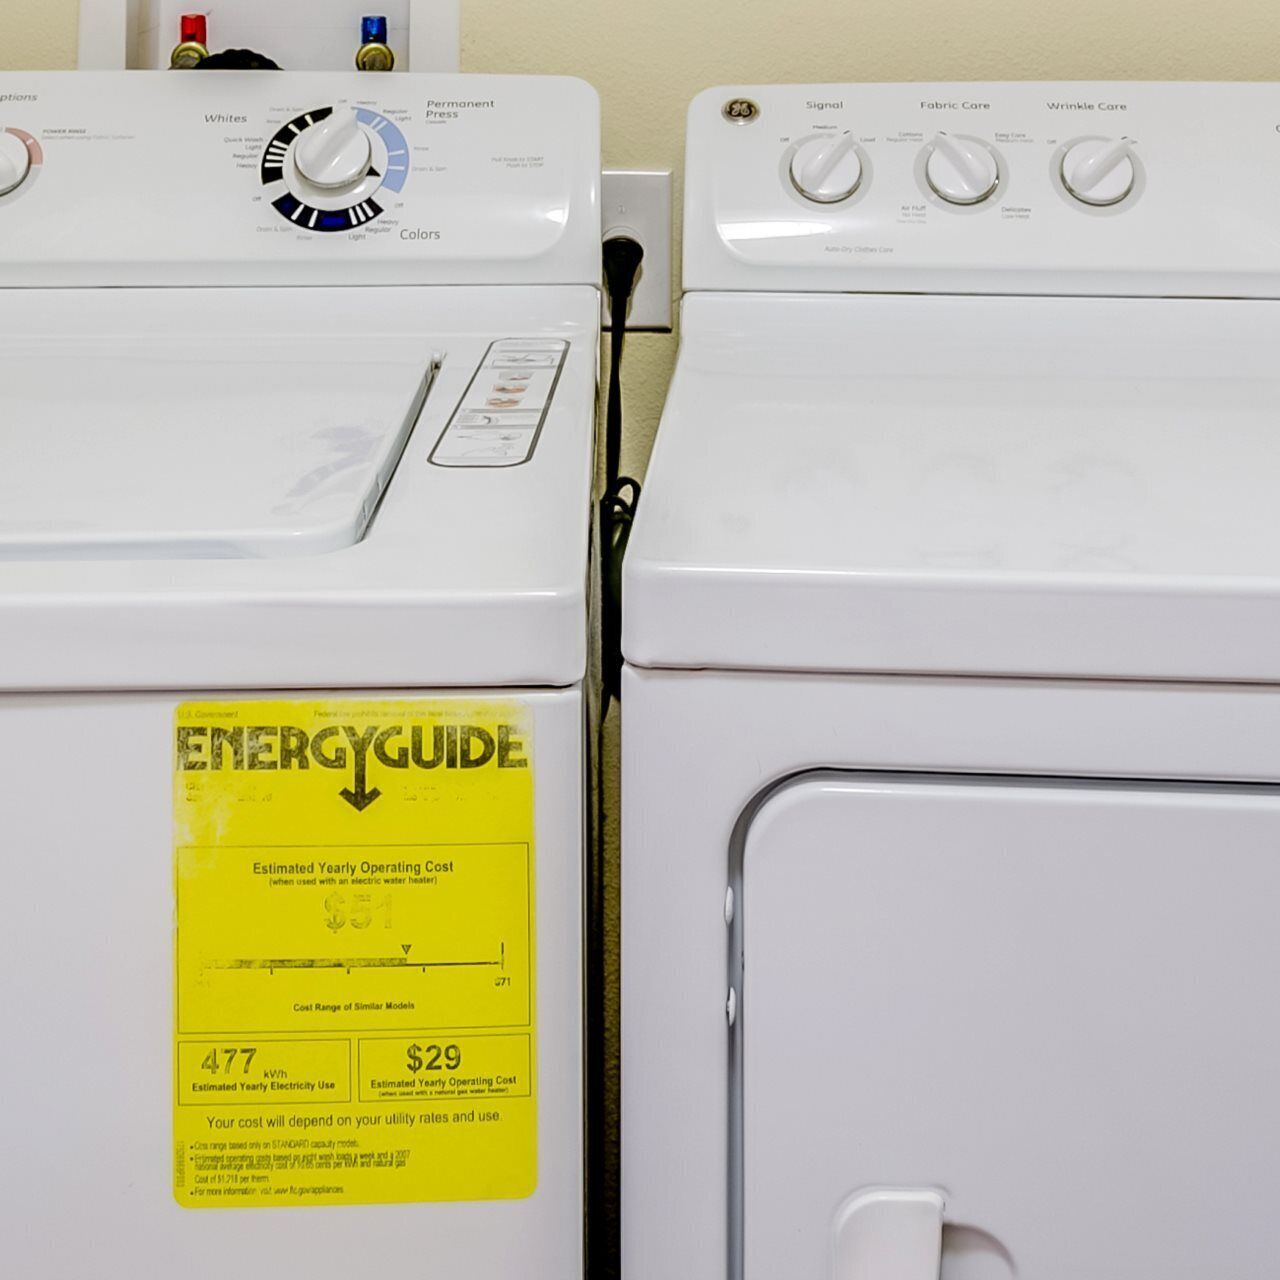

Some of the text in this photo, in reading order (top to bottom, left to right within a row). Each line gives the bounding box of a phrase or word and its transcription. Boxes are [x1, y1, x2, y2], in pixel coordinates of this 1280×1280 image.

[427, 100, 495, 108] Permanent
[806, 101, 843, 111] Signal
[920, 101, 991, 110] Fabric Care
[1047, 102, 1127, 111] Wrinkle Care
[204, 114, 247, 123] Whites
[426, 110, 459, 118] Press
[365, 226, 391, 234] Regular
[400, 228, 441, 240] Colors
[348, 233, 366, 241] Light
[176, 724, 528, 773] ENERGYGUIDE
[253, 861, 454, 877] Estimated Yearly Operating Cost
[269, 878, 294, 887] (when
[319, 877, 337, 885] with
[351, 877, 380, 885] electric
[408, 876, 437, 885] heater)
[293, 1001, 415, 1013] Cost Range of Similar Models
[201, 1048, 257, 1074] 477
[407, 1043, 461, 1074] $29
[263, 1070, 287, 1079] kWh
[192, 1081, 335, 1093] Estimated Yearly Electricity Use
[371, 1076, 517, 1089] Estimated Yearly Operating Cost
[207, 1116, 235, 1128] Your
[238, 1116, 263, 1128] cost
[266, 1115, 285, 1127] will
[288, 1114, 333, 1130] depend
[337, 1116, 351, 1126] on
[355, 1116, 382, 1129] your
[385, 1113, 415, 1127] utility
[420, 1112, 449, 1124] rates
[452, 1110, 475, 1122] and
